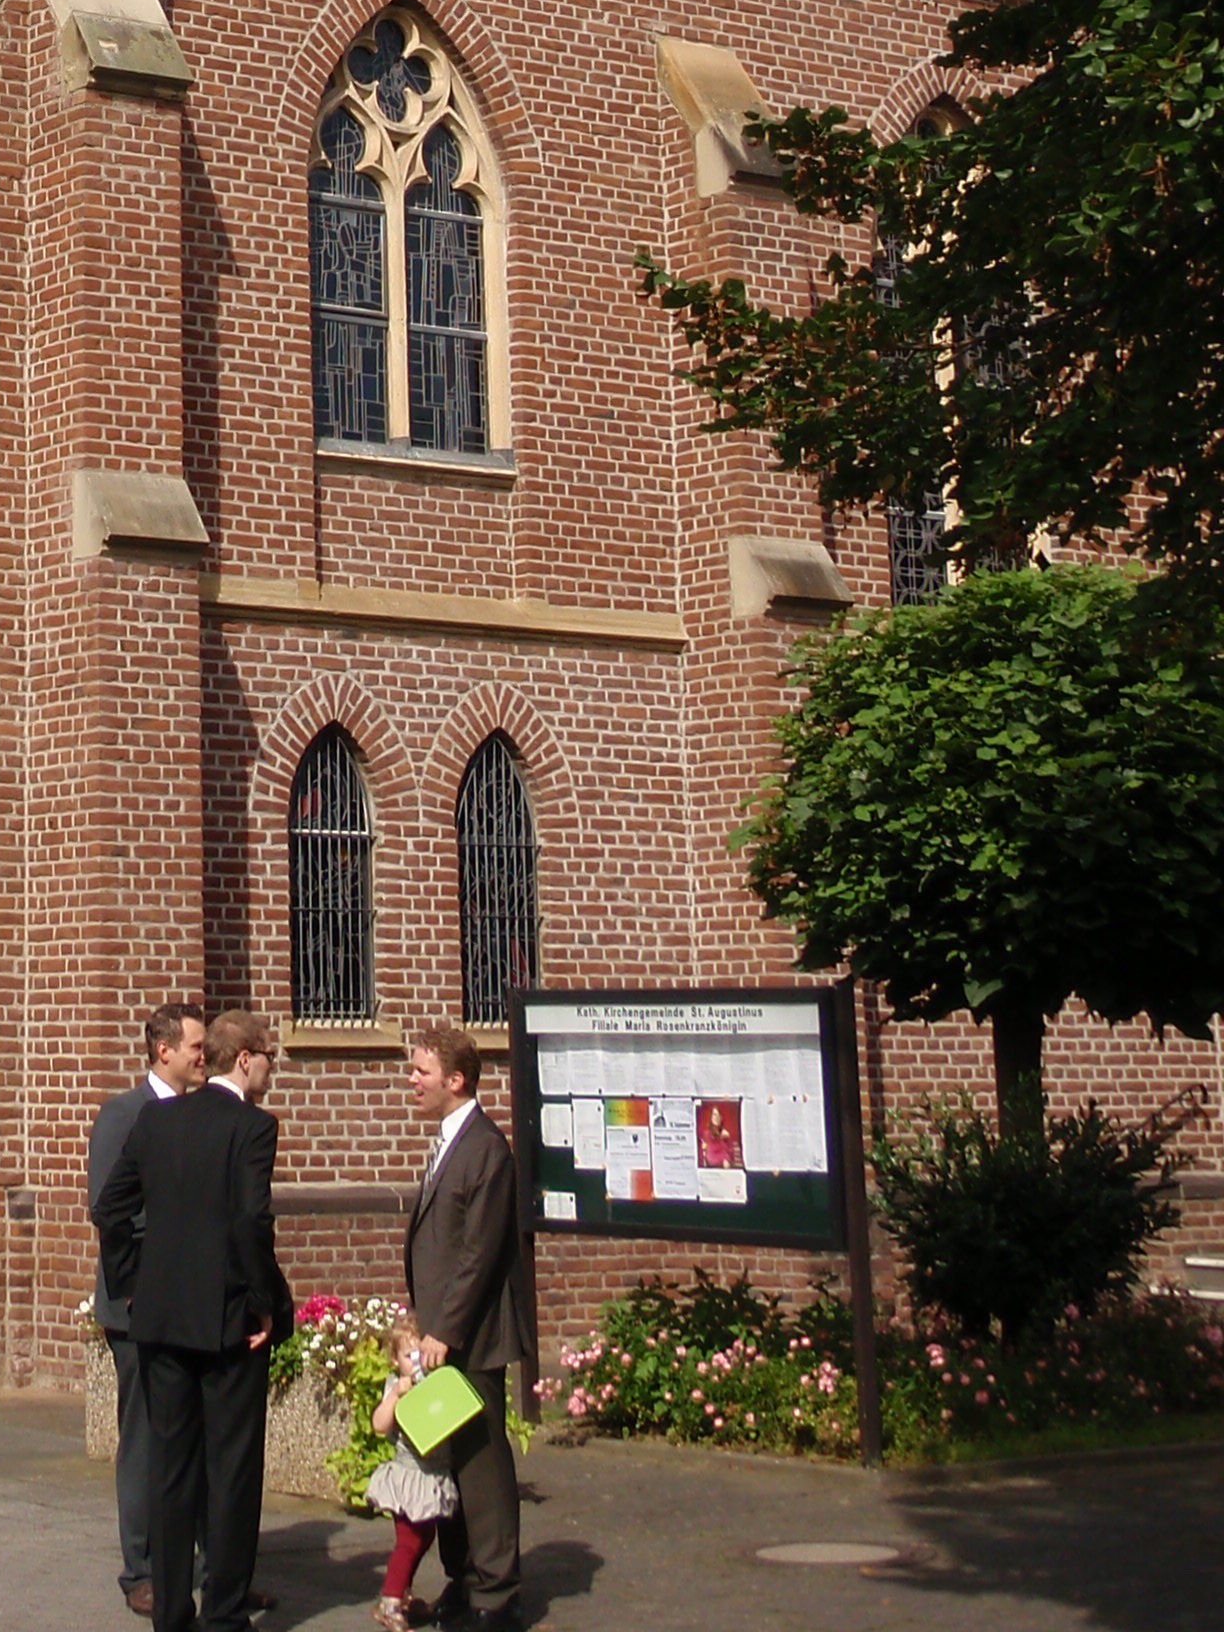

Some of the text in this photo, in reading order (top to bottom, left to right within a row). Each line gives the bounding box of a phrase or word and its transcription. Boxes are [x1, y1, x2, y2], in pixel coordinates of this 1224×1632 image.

[604, 1006, 684, 1019] Kirchengemeinde
[690, 1006, 705, 1017] St.
[708, 1006, 763, 1019] Augustinus
[591, 1019, 748, 1034] Filiale Maria Rosenkranzkönigin
